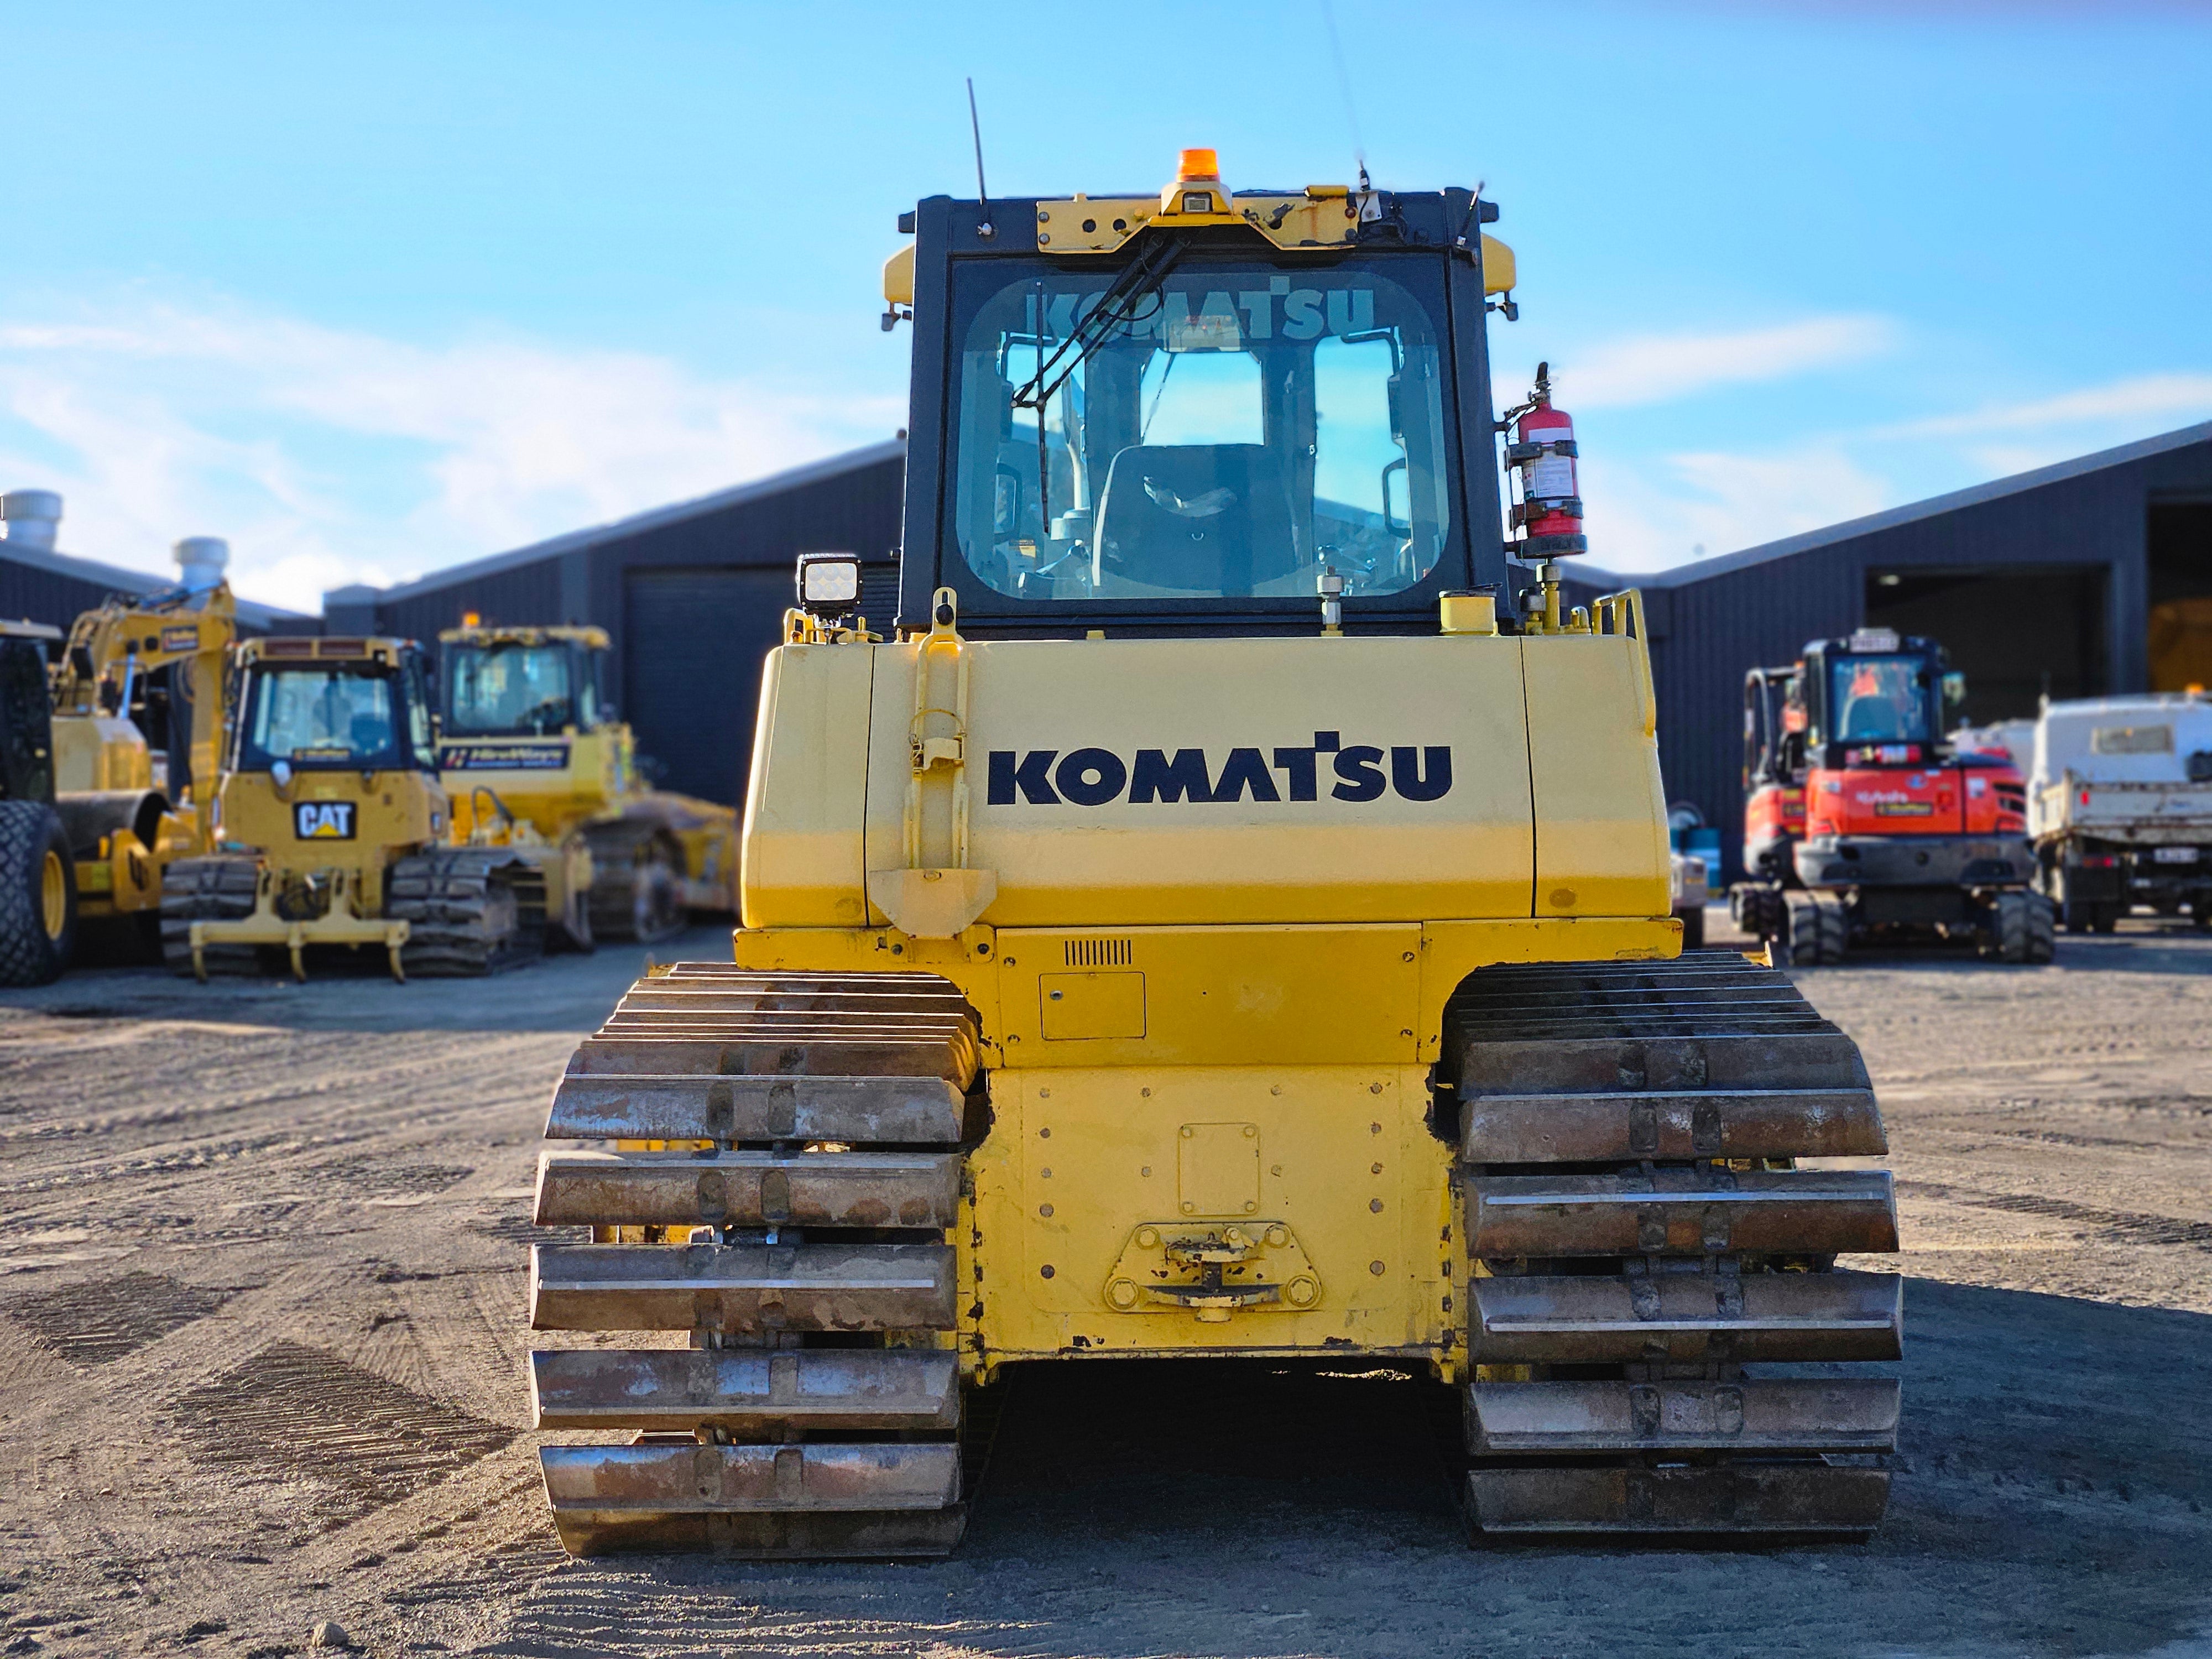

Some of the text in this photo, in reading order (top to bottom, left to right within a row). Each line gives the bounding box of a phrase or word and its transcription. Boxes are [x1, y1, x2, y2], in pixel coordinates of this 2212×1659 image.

[1026, 276, 1374, 342] KOMATSU
[988, 731, 1452, 806] KOMATSU
[299, 804, 352, 837] CAT
